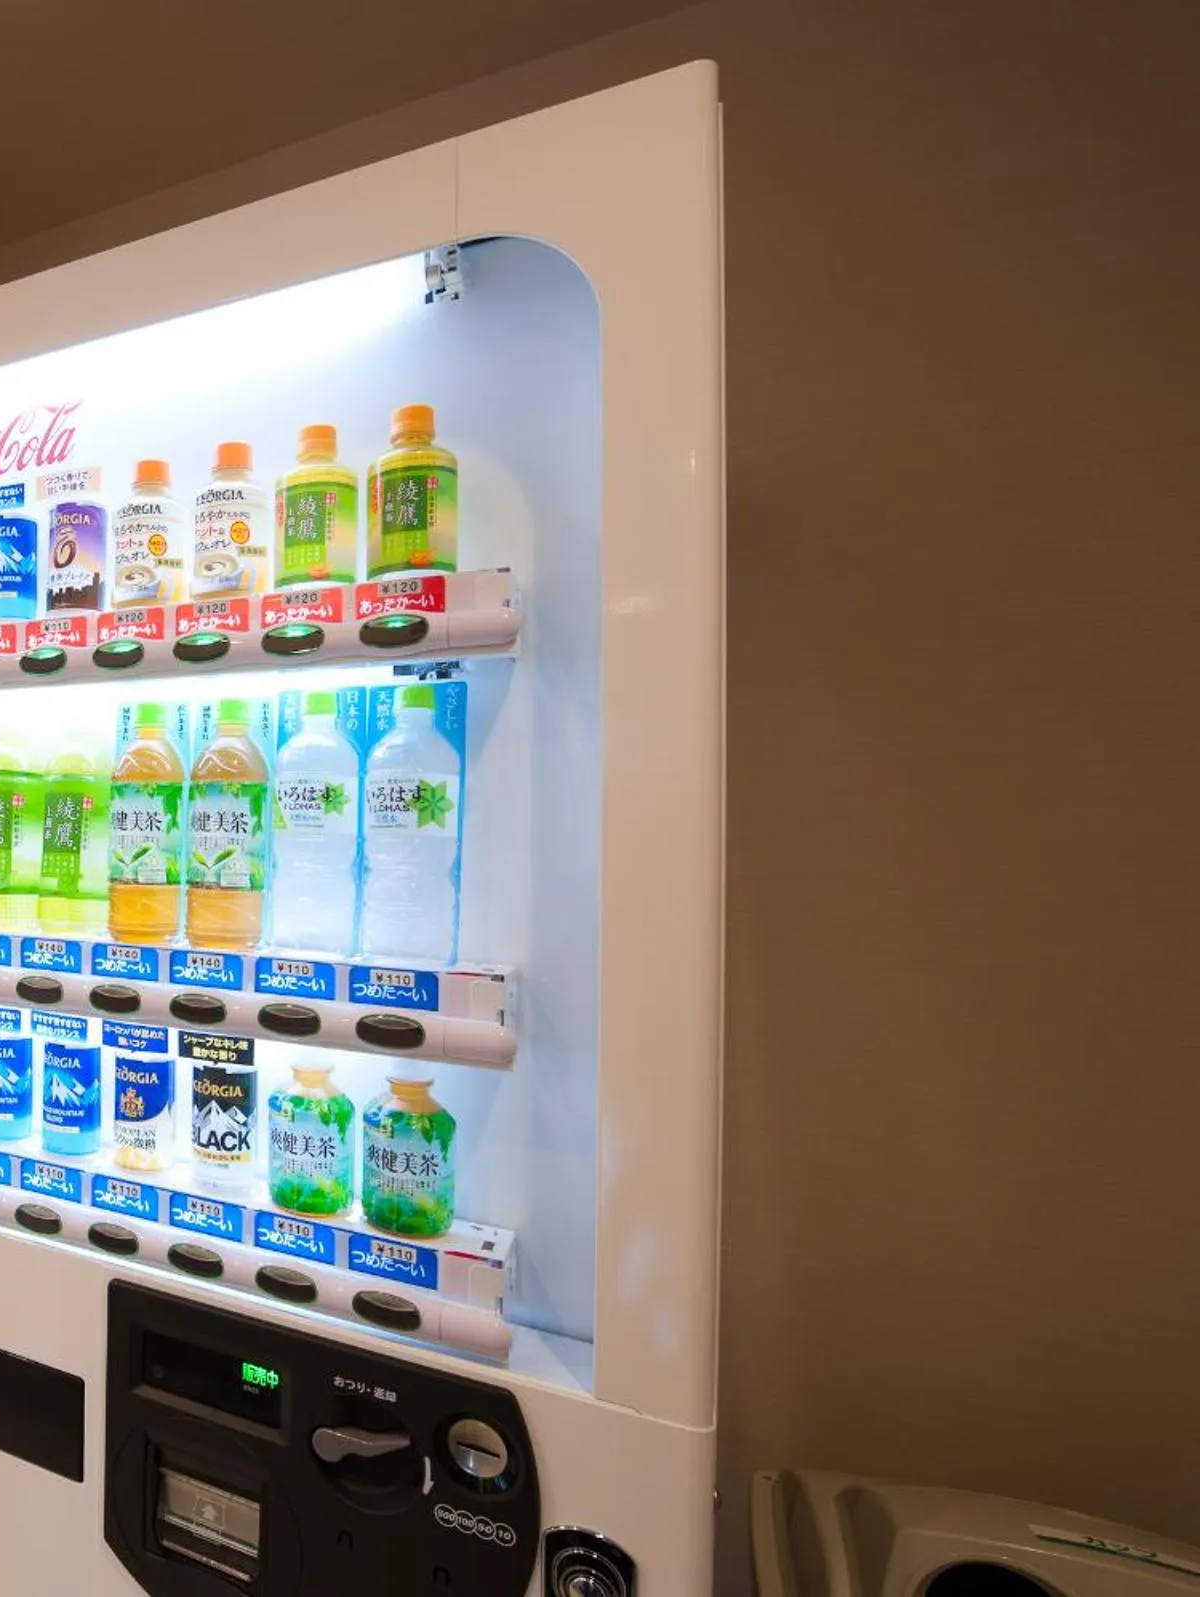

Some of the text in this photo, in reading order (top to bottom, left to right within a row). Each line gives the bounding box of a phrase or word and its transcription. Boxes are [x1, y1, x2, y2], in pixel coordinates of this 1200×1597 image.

[397, 480, 419, 526] 綾鷹
[382, 581, 418, 594] ¥120
[198, 602, 227, 614] ¥120
[346, 690, 360, 731] 日本の
[111, 810, 163, 832] 健美茶
[191, 810, 249, 834] 健美茶
[111, 949, 139, 960] ¥140
[191, 956, 220, 968] ¥140
[277, 963, 310, 976] ¥110
[375, 972, 411, 987] ¥110
[193, 1126, 250, 1152] LACK
[368, 1144, 440, 1177] 爽健美茶
[110, 1183, 138, 1196] ¥110
[191, 1201, 220, 1216] ¥110
[277, 1219, 310, 1237] ¥110
[376, 1243, 413, 1261] ¥110
[242, 1362, 279, 1389] 販売中
